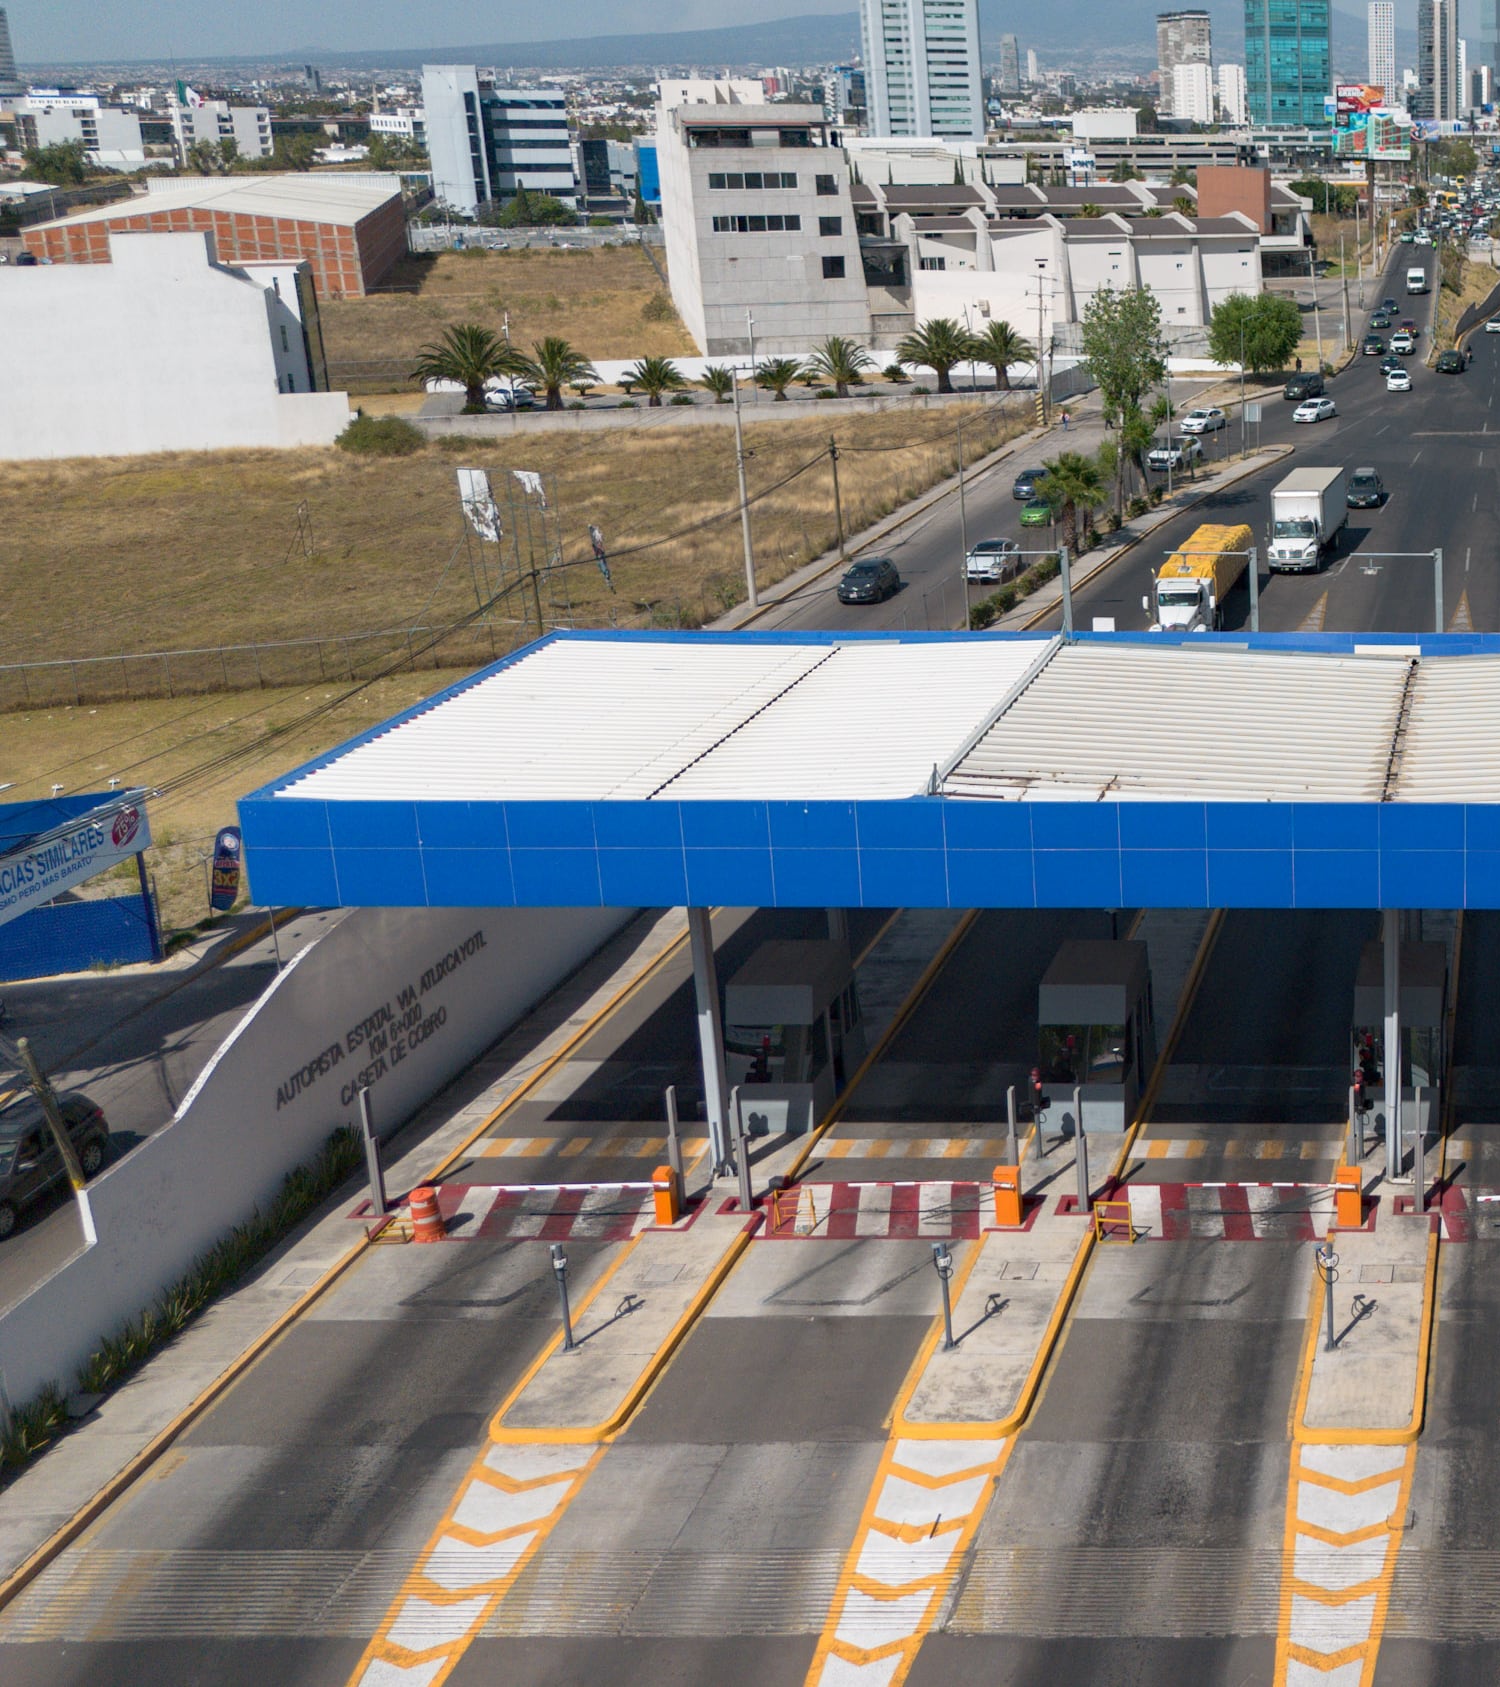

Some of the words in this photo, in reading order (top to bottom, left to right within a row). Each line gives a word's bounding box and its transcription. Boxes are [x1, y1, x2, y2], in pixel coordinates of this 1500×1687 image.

[37, 827, 105, 876] SIMILARES
[19, 882, 41, 900] PERO
[42, 871, 60, 888] MAS
[275, 1042, 345, 1111] AUTOPISTA
[346, 1003, 395, 1053] ESTATAL
[396, 984, 418, 1010] VIA
[419, 930, 488, 996] ATLIXCAYOTL
[369, 1031, 389, 1060] KM
[389, 1003, 423, 1042] 6+000
[341, 1056, 389, 1106] CASETA
[390, 1038, 407, 1067] DE
[408, 1005, 448, 1050] COBRO
